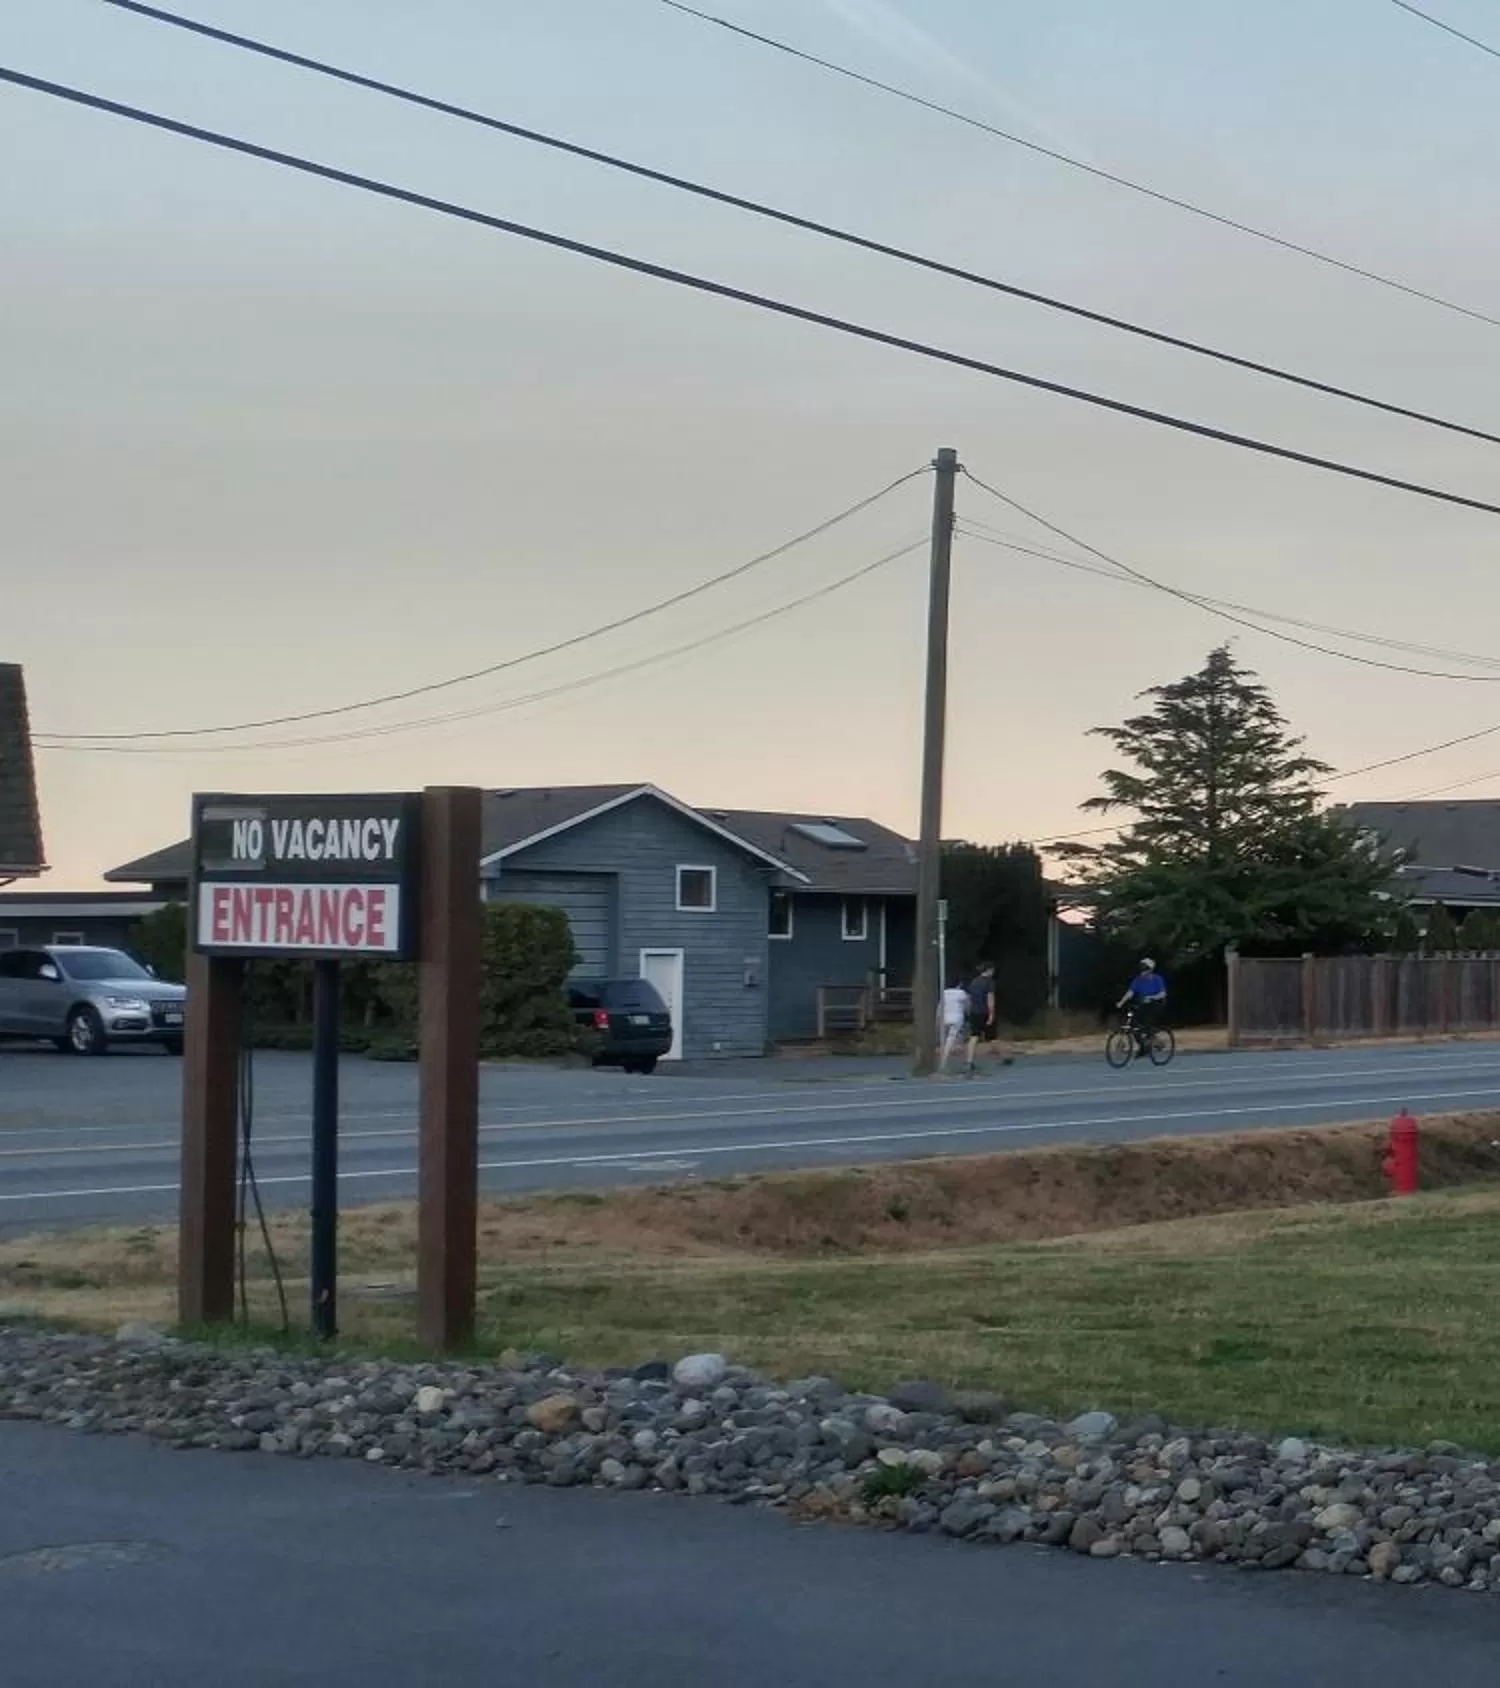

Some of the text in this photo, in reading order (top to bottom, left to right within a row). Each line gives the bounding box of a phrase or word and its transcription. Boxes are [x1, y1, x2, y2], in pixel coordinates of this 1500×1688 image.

[232, 817, 400, 861] NO VACANCY
[211, 887, 386, 947] ENTRANCE
